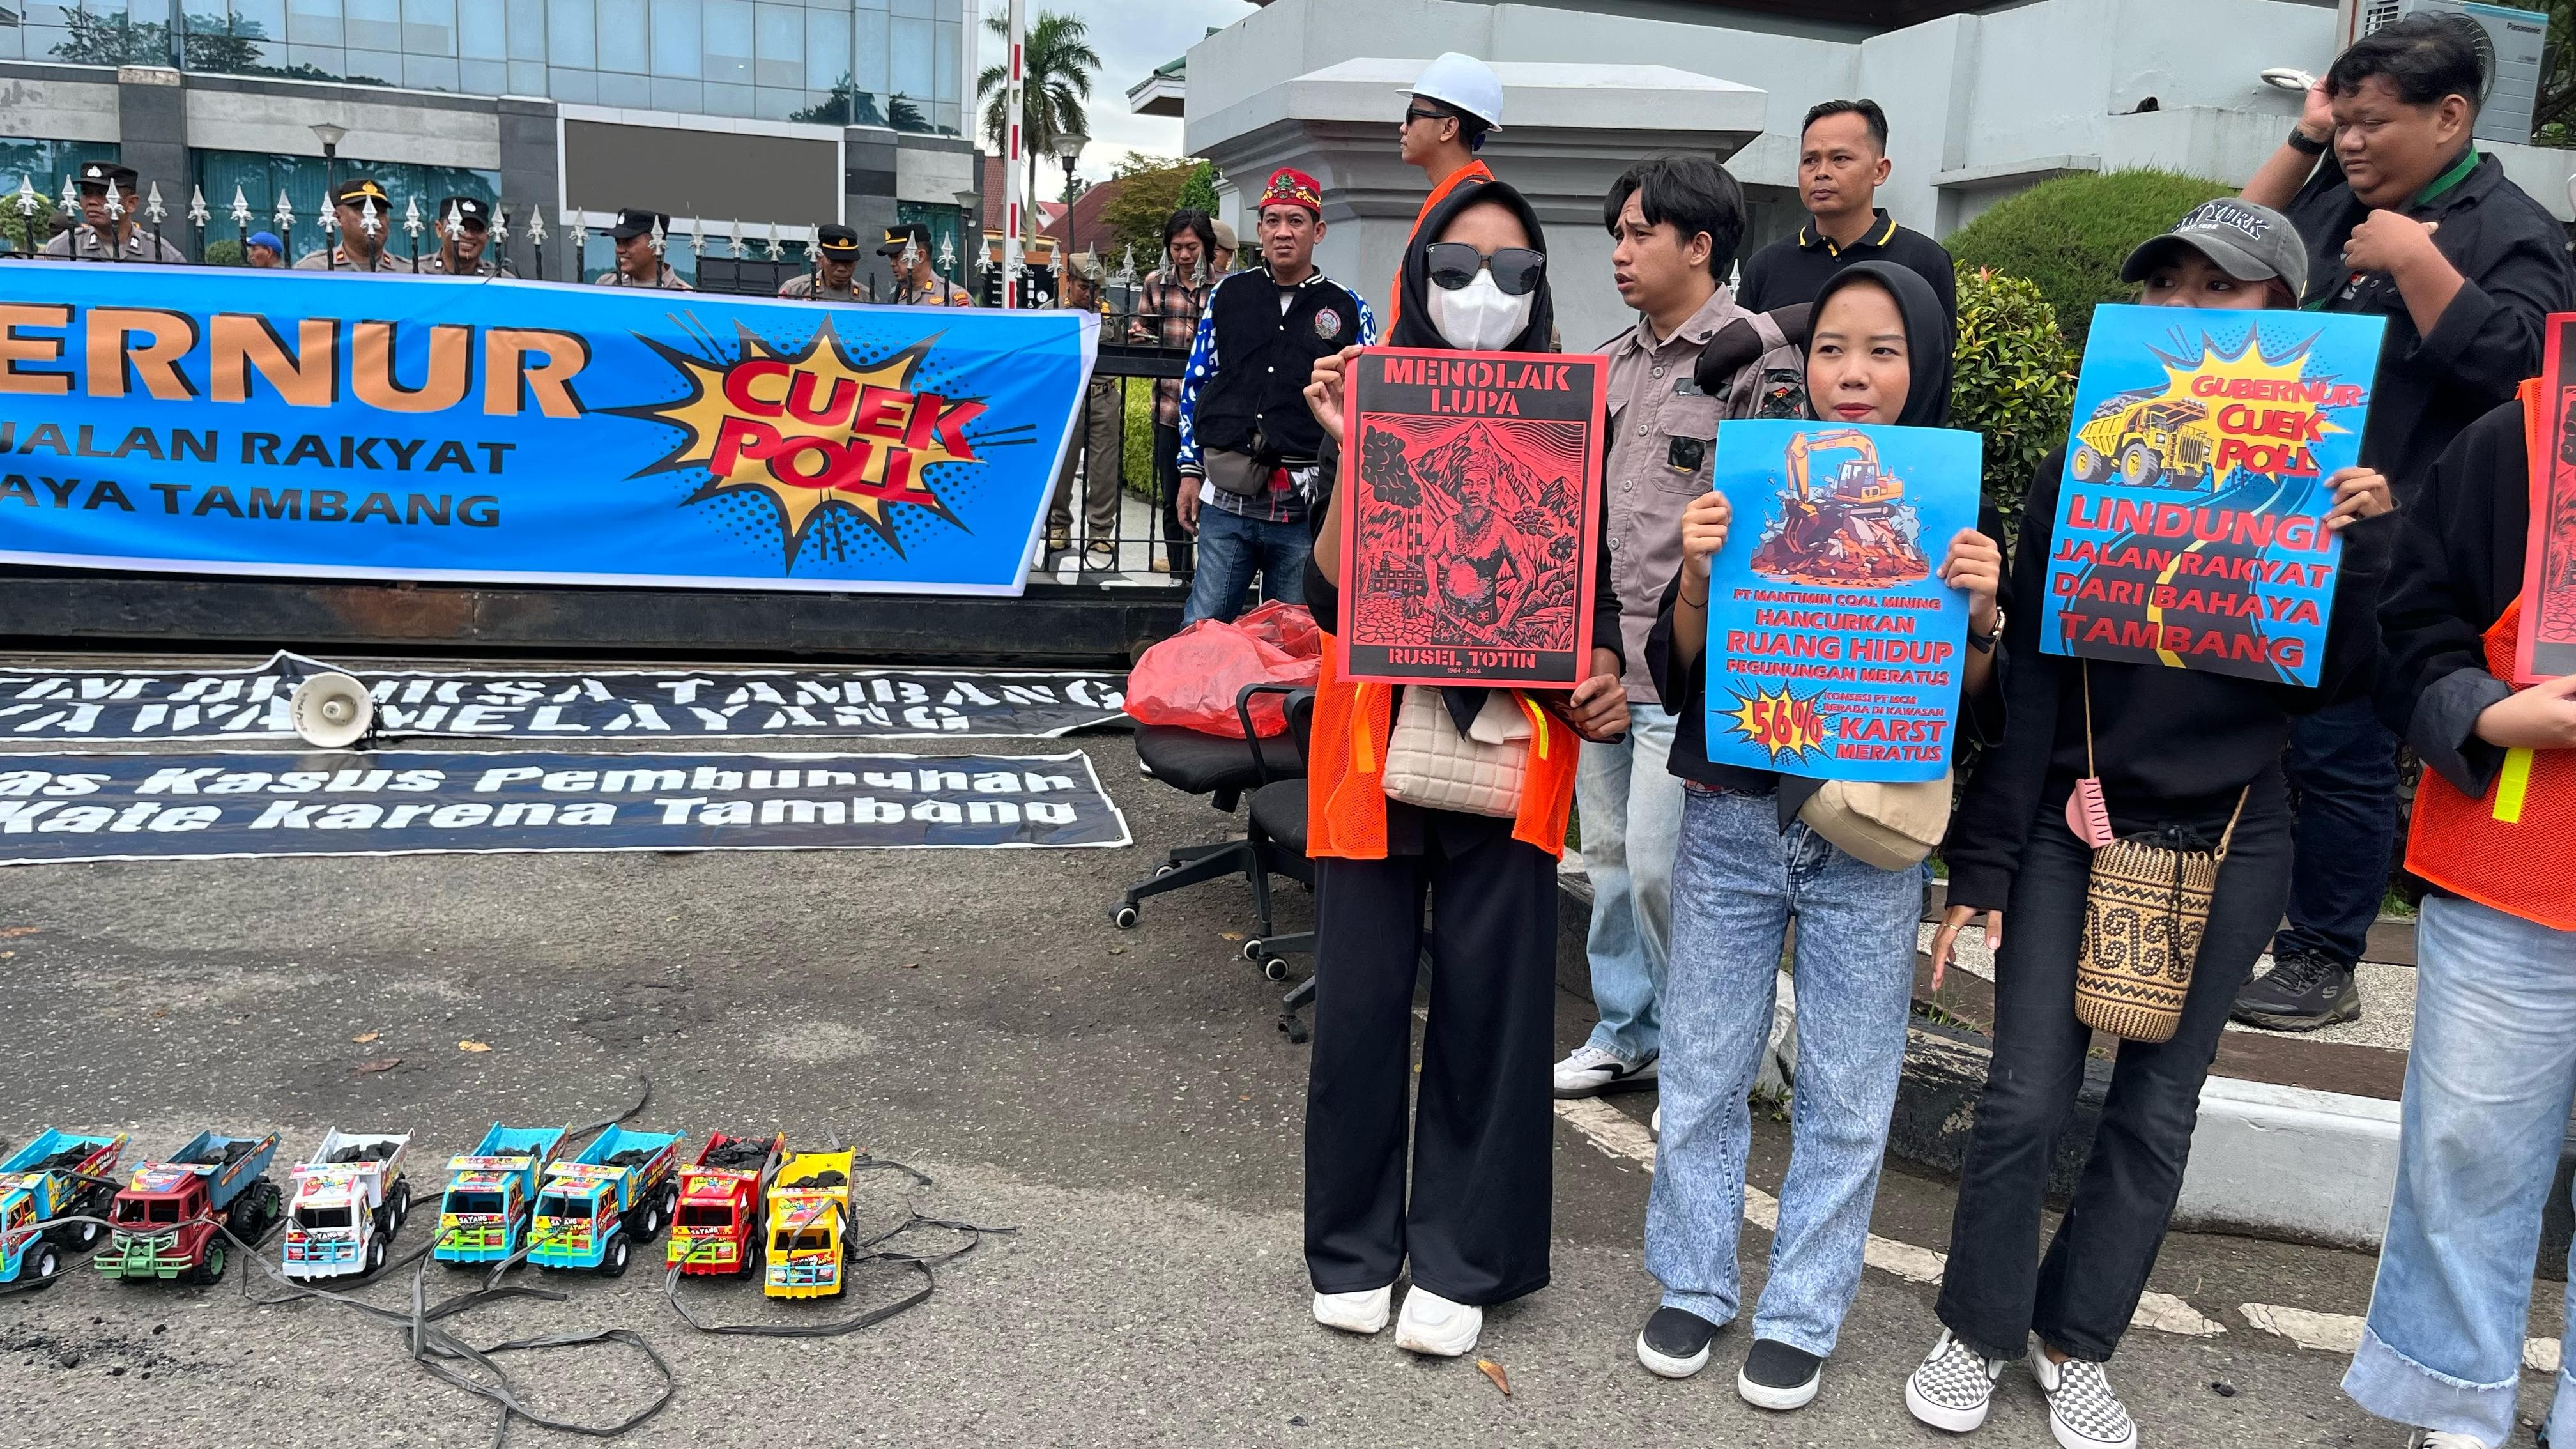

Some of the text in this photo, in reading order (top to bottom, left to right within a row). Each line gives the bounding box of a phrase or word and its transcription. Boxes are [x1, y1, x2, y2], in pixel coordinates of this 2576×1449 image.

[2507, 22, 2541, 34] Panasonic
[1384, 358, 1572, 392] MENOLAK
[2191, 374, 2365, 407] GUBERNUR
[722, 360, 990, 461] CUEK
[1431, 388, 1520, 416] LUPA
[2217, 404, 2327, 442] CUEK
[0, 422, 516, 475] JALAN RAKYAT
[709, 415, 935, 505] POLL
[2214, 438, 2320, 477] POLL
[150, 484, 500, 528] TAMBANG
[2066, 493, 2332, 553] LINDUNGI
[2053, 539, 2333, 589] JALAN RAKYAT
[1733, 588, 1942, 611] PT MANTIMIN COAL MINING
[2053, 572, 2320, 627] DARI BAHAYA
[1756, 609, 1915, 634] HANCURKAN
[1726, 630, 1953, 665] RUANG HIDUP
[2058, 610, 2306, 668] TAMBANG
[1388, 648, 1537, 668] RUSEL TOTIN
[1726, 658, 1950, 686] PEGUNUNGAN MERATUS
[658, 678, 1125, 710] TAMBANG
[1823, 703, 1945, 716] BERADA DI KAWASAN
[1824, 691, 1917, 704] KONSESI PT MCM
[1751, 699, 1823, 744] 56%
[1839, 716, 1948, 743] KARST
[1835, 743, 1943, 762] MERATUS
[134, 767, 446, 794] Kasus
[474, 766, 1075, 793] Pembunuhan
[0, 801, 223, 834] Kate
[654, 797, 1078, 826] Tambang
[459, 1215, 487, 1224] SAYANG
[550, 1218, 578, 1227] SAANG
